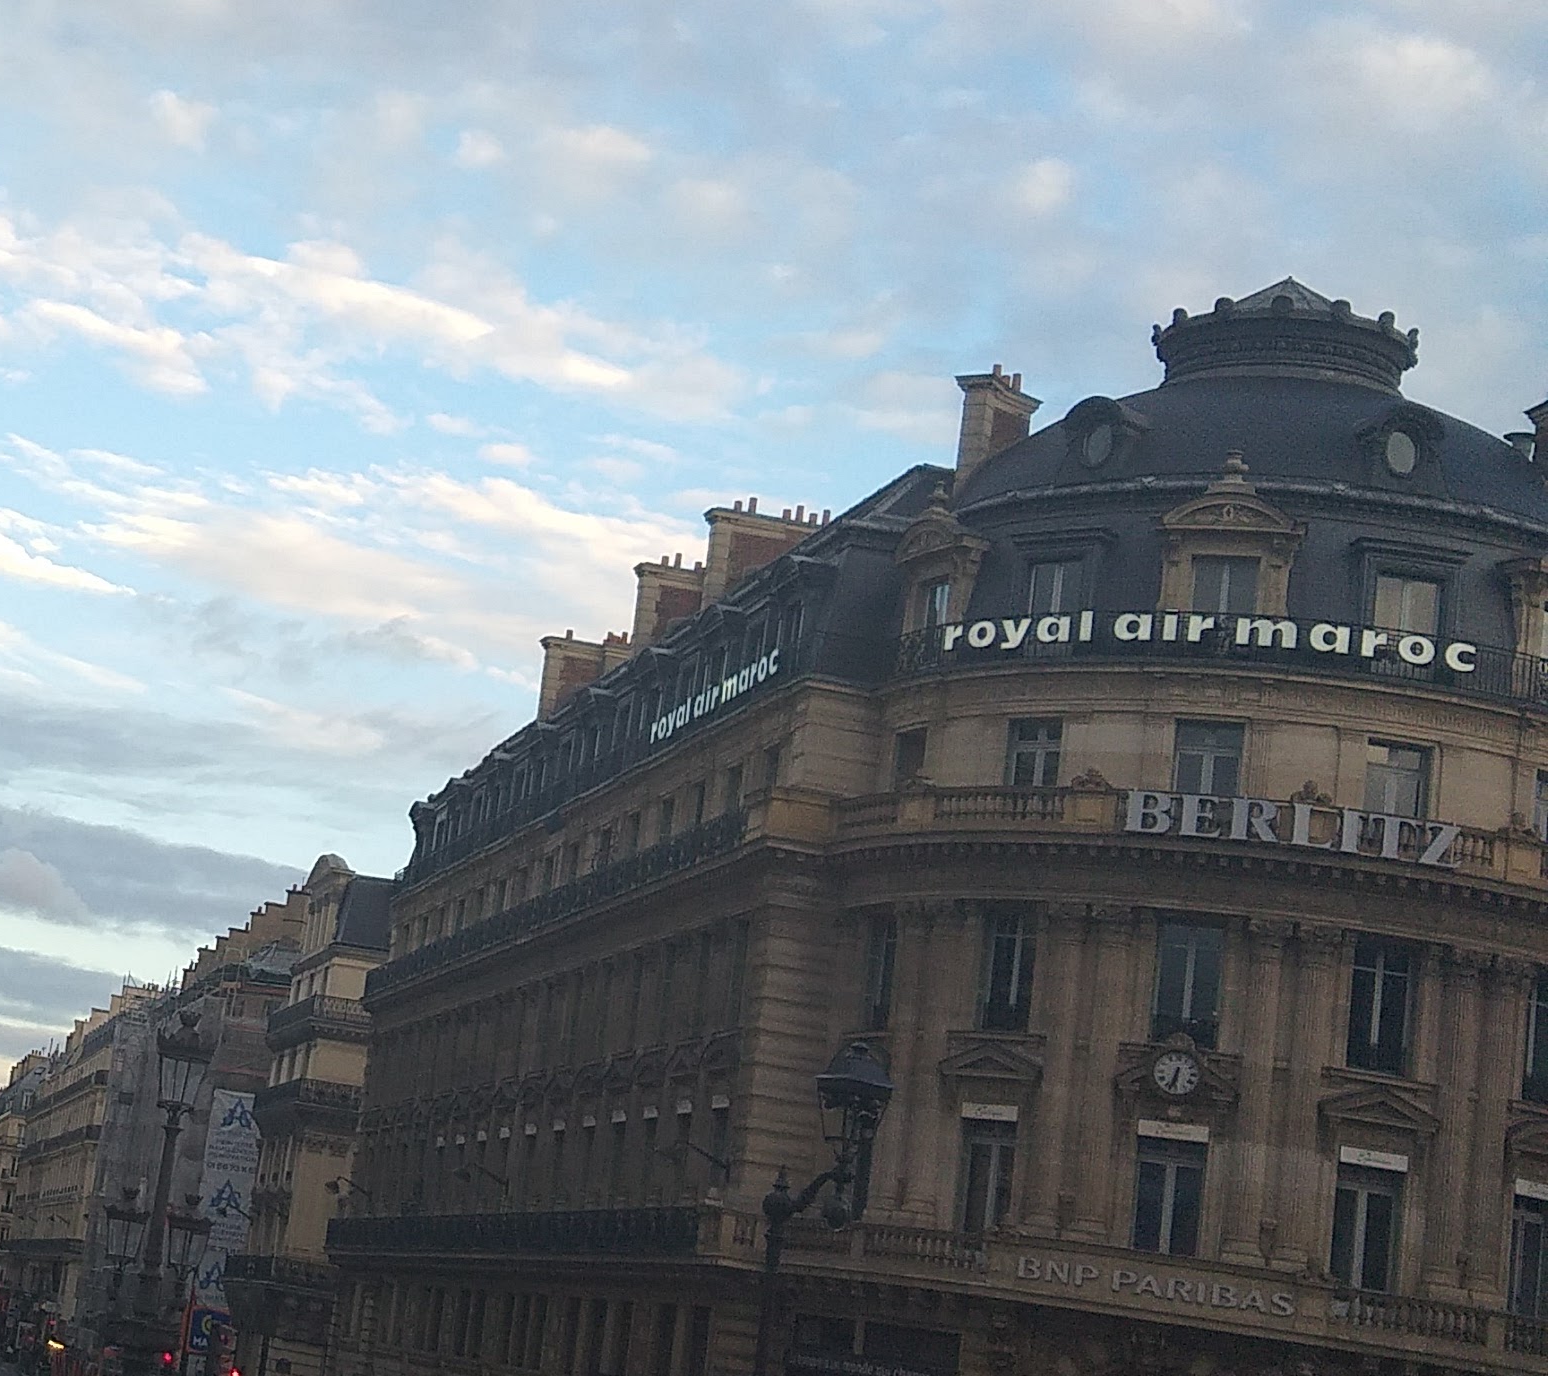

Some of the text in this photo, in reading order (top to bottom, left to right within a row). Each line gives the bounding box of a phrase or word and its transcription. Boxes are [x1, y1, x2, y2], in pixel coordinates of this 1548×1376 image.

[944, 609, 1477, 672] royal air maroc
[650, 648, 780, 744] royal air maroc
[1124, 789, 1461, 868] BERLITZ
[1017, 1256, 1296, 1317] BNP PARIBAS
